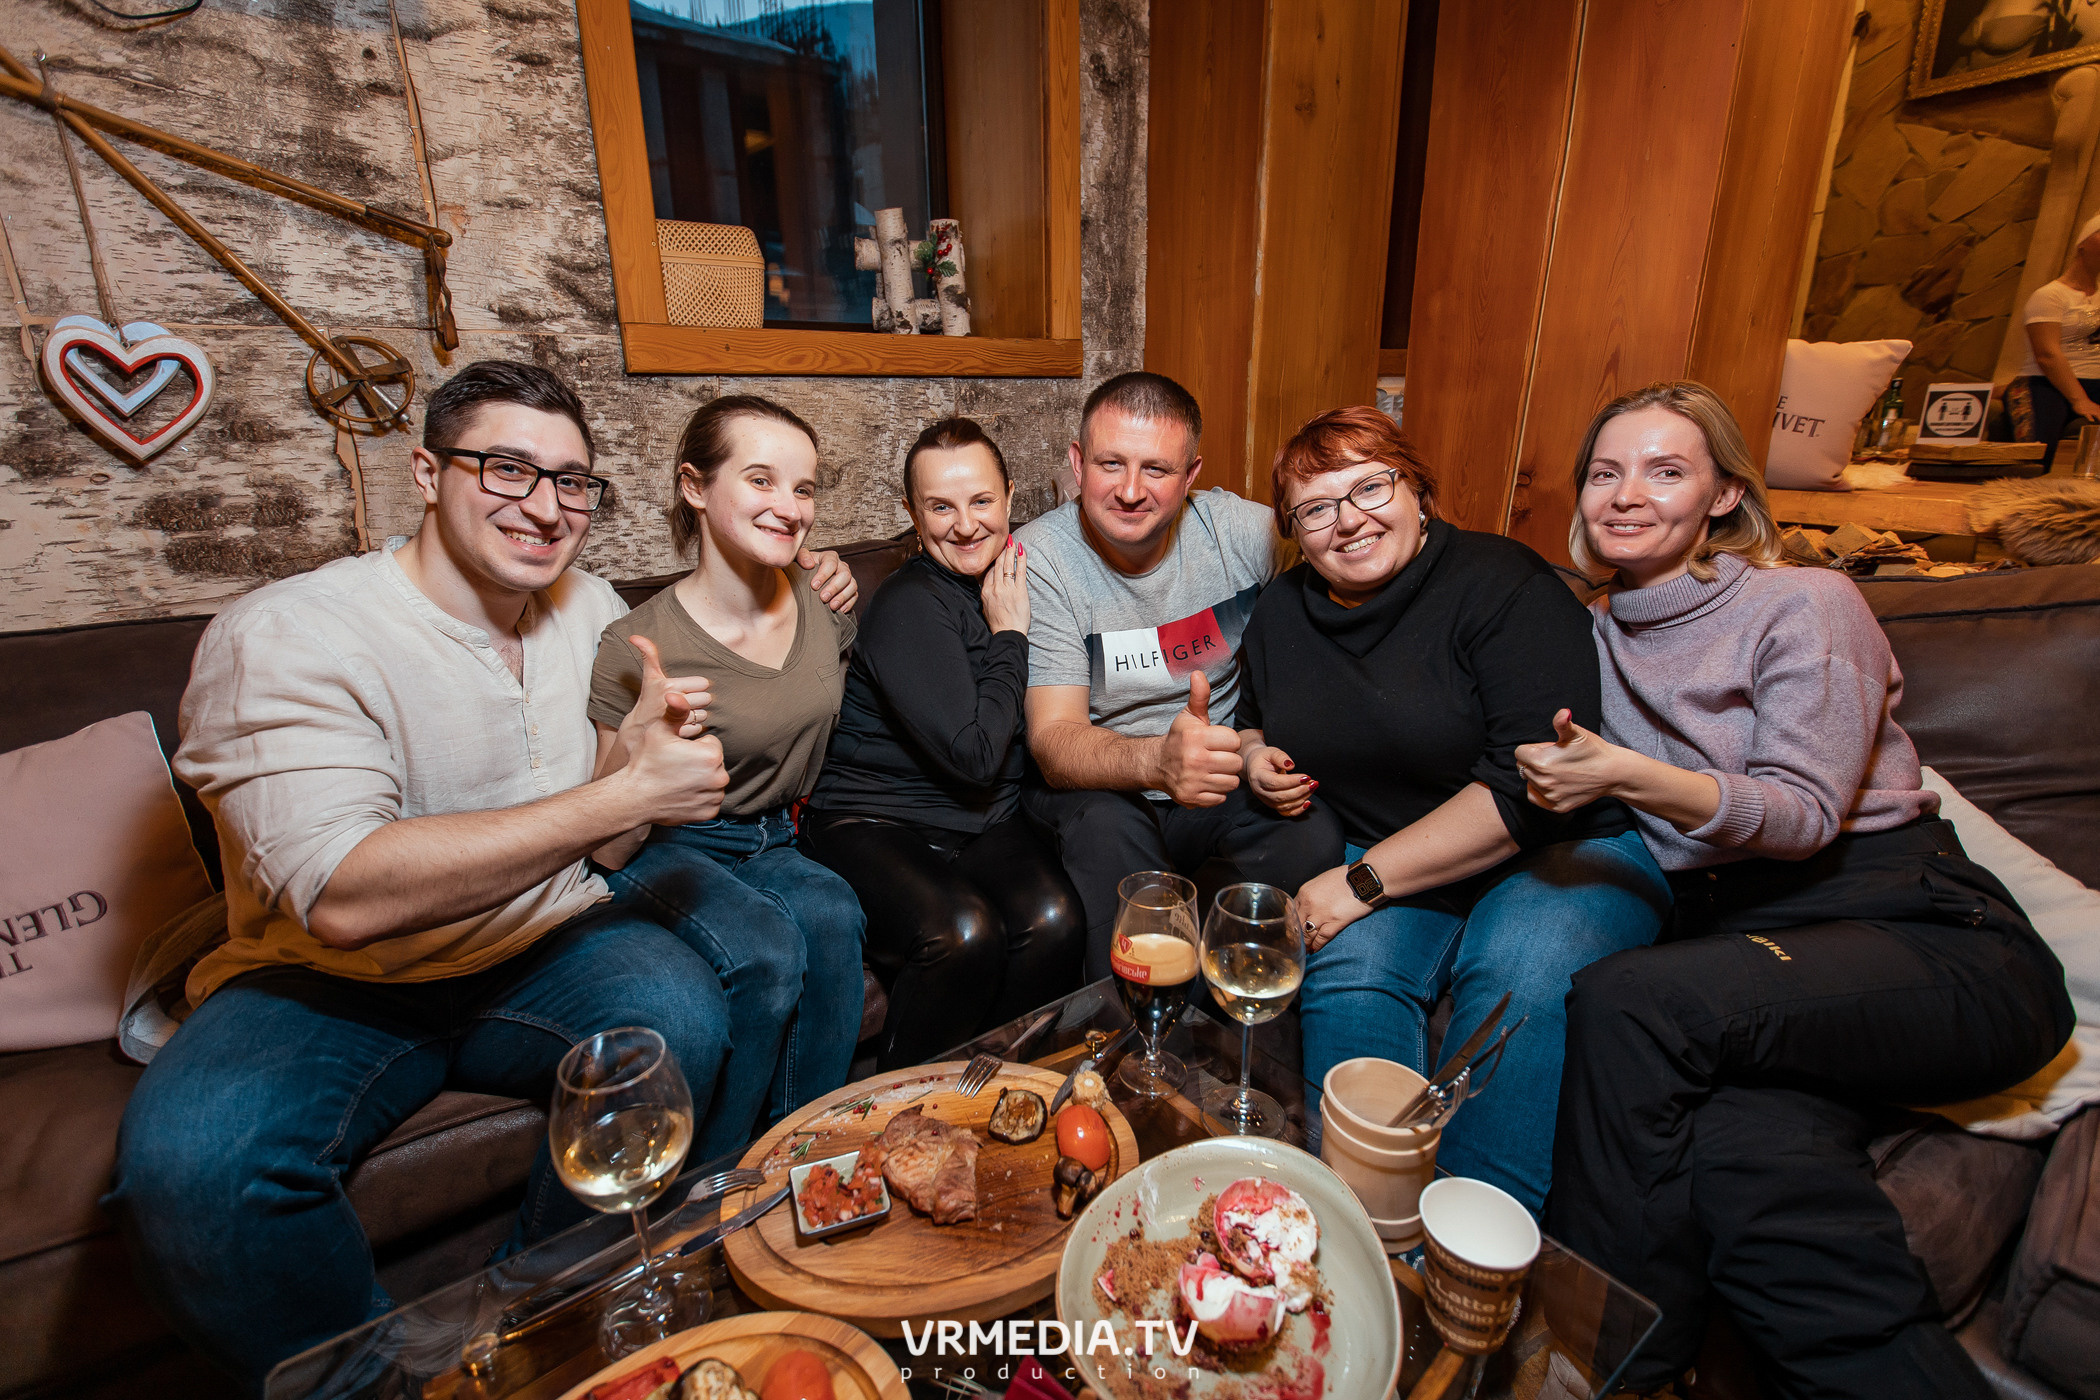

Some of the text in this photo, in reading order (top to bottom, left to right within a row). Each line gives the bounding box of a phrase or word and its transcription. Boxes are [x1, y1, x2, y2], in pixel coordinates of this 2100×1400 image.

[1772, 411, 1826, 438] IVET
[1115, 634, 1217, 672] HILFIGER
[0, 890, 108, 947] GLEN
